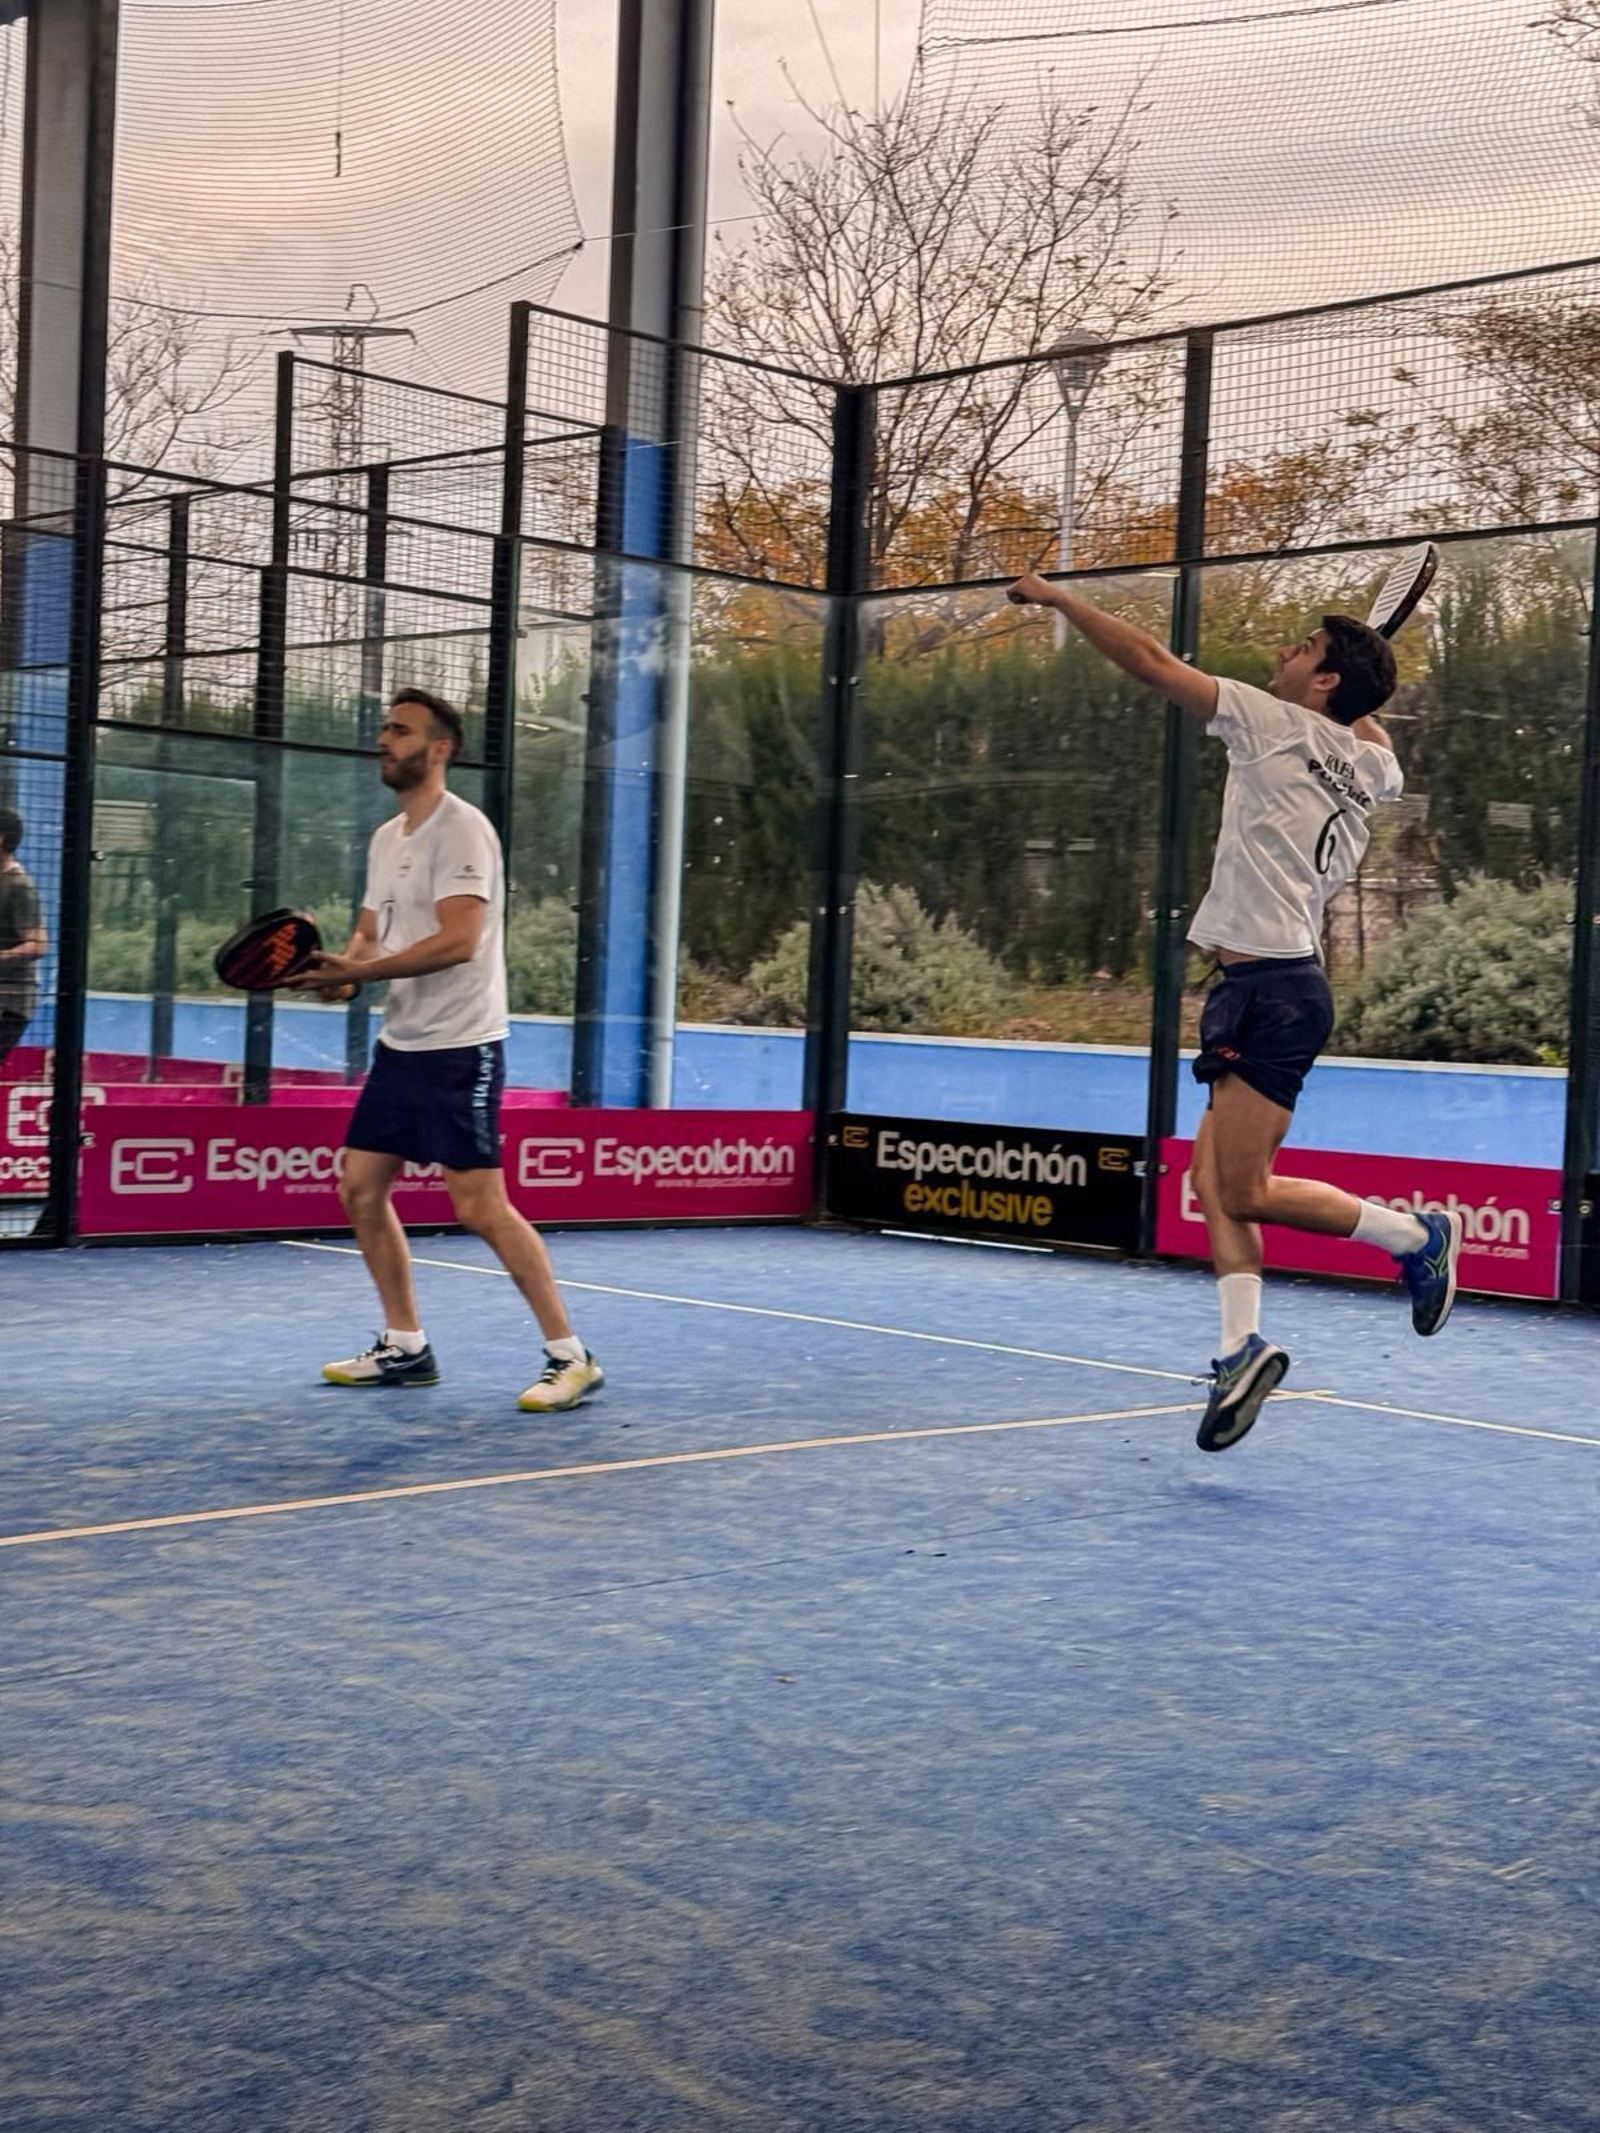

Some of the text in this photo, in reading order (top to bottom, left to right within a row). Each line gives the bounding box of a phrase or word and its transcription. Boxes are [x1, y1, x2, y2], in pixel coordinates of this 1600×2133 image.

[1315, 808, 1346, 875] 6
[594, 1137, 795, 1185] Especolchón
[876, 1130, 1087, 1187] Especolchón
[904, 1179, 1053, 1226] exclusive
